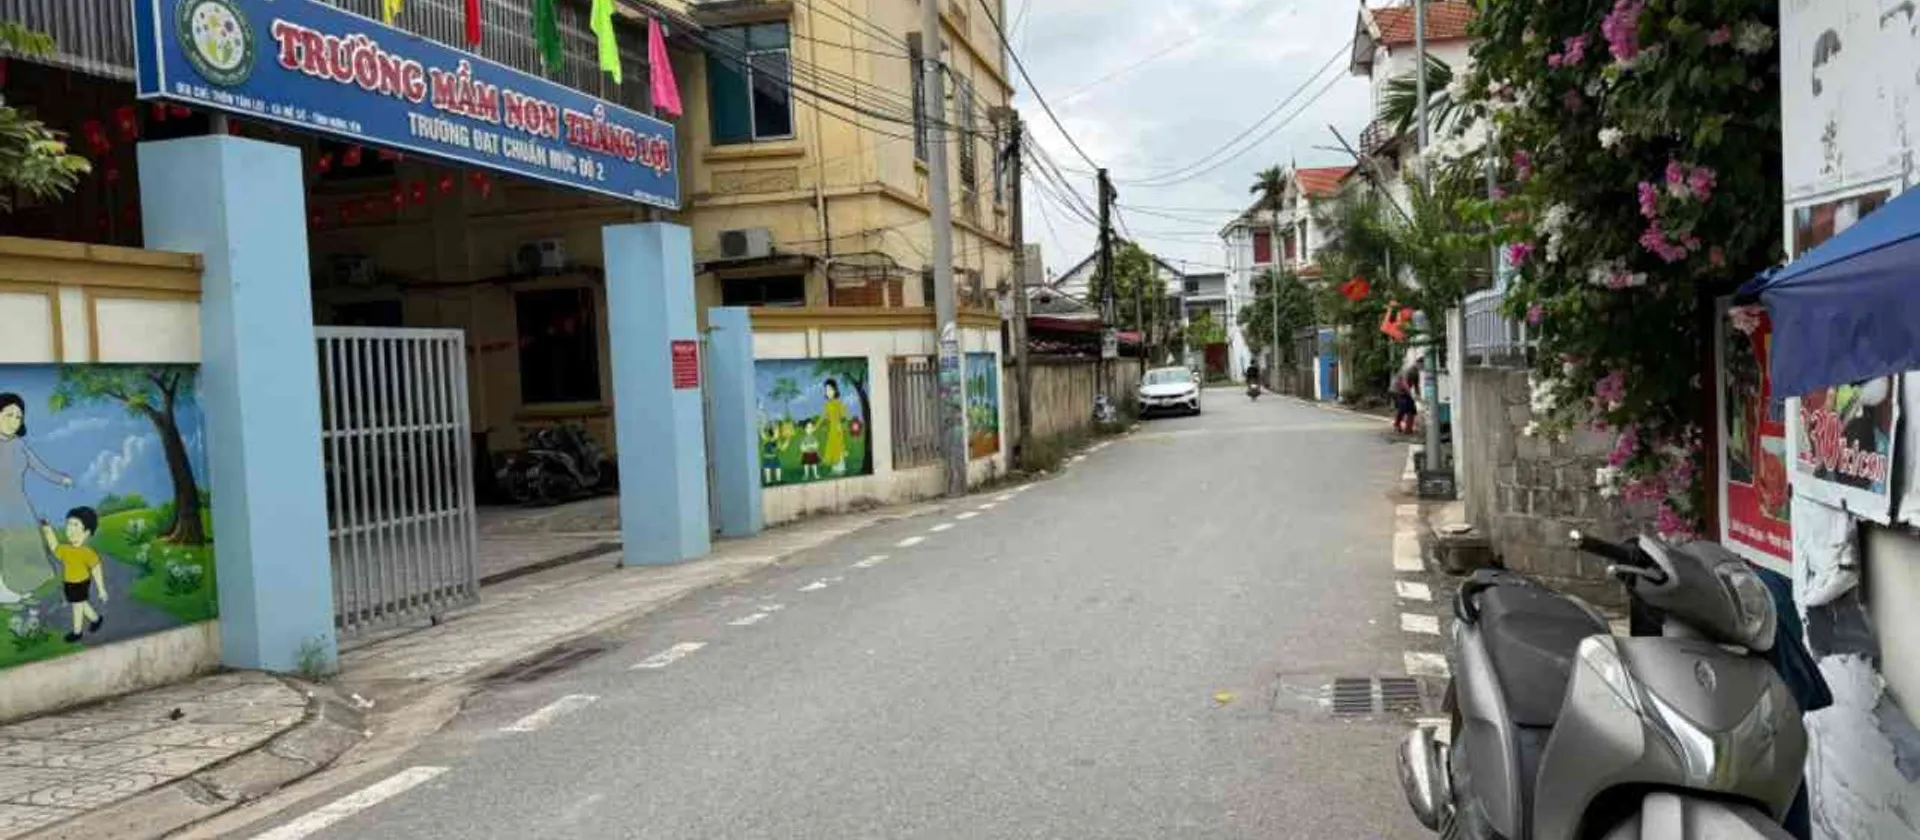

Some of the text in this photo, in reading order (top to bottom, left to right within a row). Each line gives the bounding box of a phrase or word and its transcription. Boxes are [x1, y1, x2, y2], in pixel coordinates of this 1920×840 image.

[271, 18, 427, 103] TRƯỜNG
[428, 59, 500, 124] MẦM
[502, 89, 560, 139] NON
[638, 133, 672, 178] LỢI
[408, 111, 470, 148] TRƯỜNG
[472, 128, 500, 156] ĐẠT
[596, 161, 606, 181] 2
